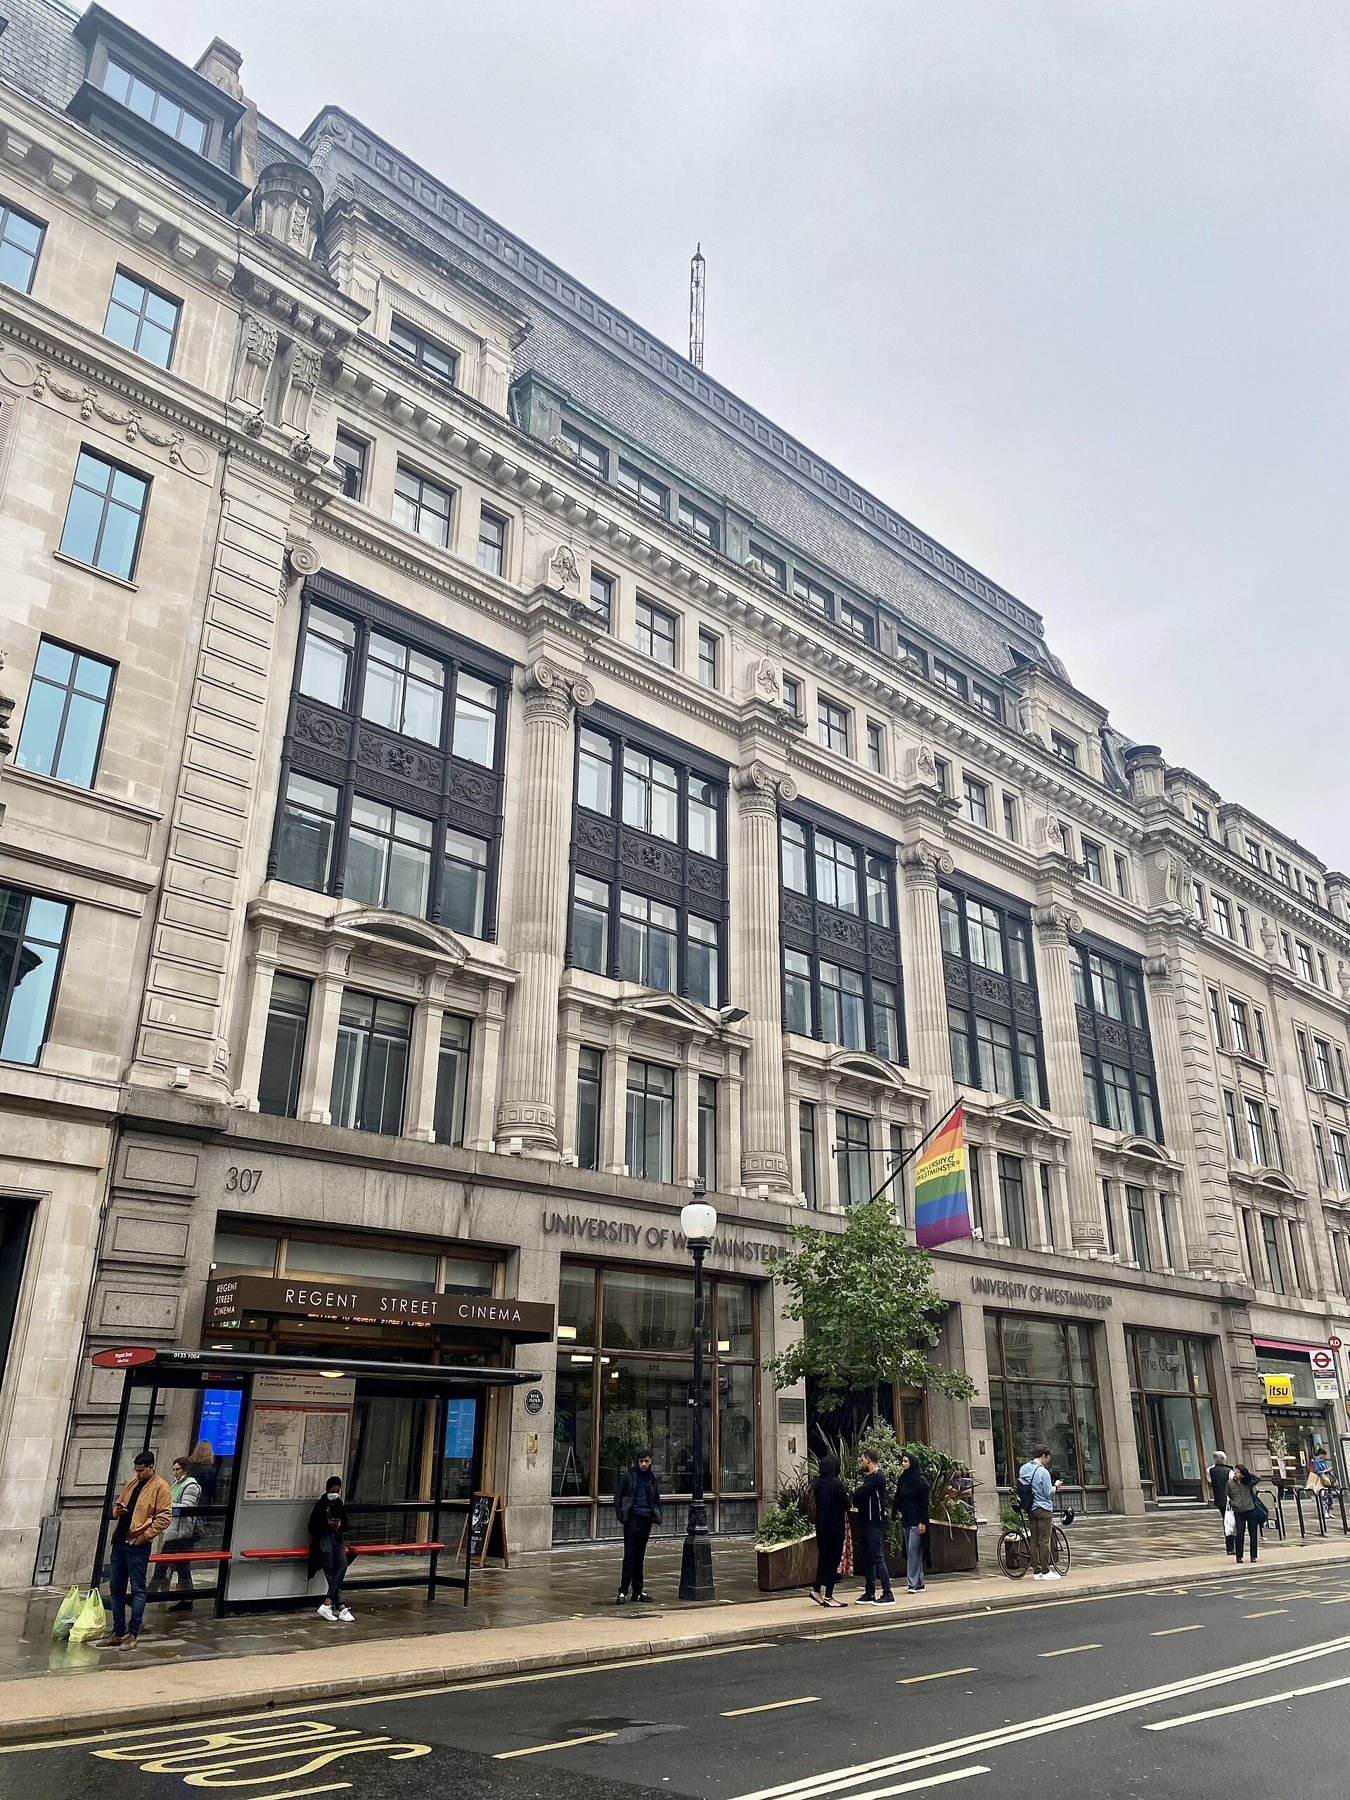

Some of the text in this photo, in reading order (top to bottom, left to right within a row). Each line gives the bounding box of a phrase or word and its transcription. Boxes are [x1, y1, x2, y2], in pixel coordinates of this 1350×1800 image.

[226, 1166, 263, 1194] 307
[542, 1211, 642, 1244] UNIVERSITY
[646, 1227, 669, 1248] OF
[216, 1282, 238, 1293] REGENT
[971, 1276, 1108, 1310] UNIVERSITY OF WESTMINSTER
[215, 1294, 233, 1305] STREET
[285, 1289, 521, 1322] REGENT STREET CINEMA
[213, 1306, 235, 1317] CINEMA
[1141, 1355, 1157, 1371] The
[1269, 1385, 1289, 1396] itsu
[89, 1721, 432, 1787] BUS
